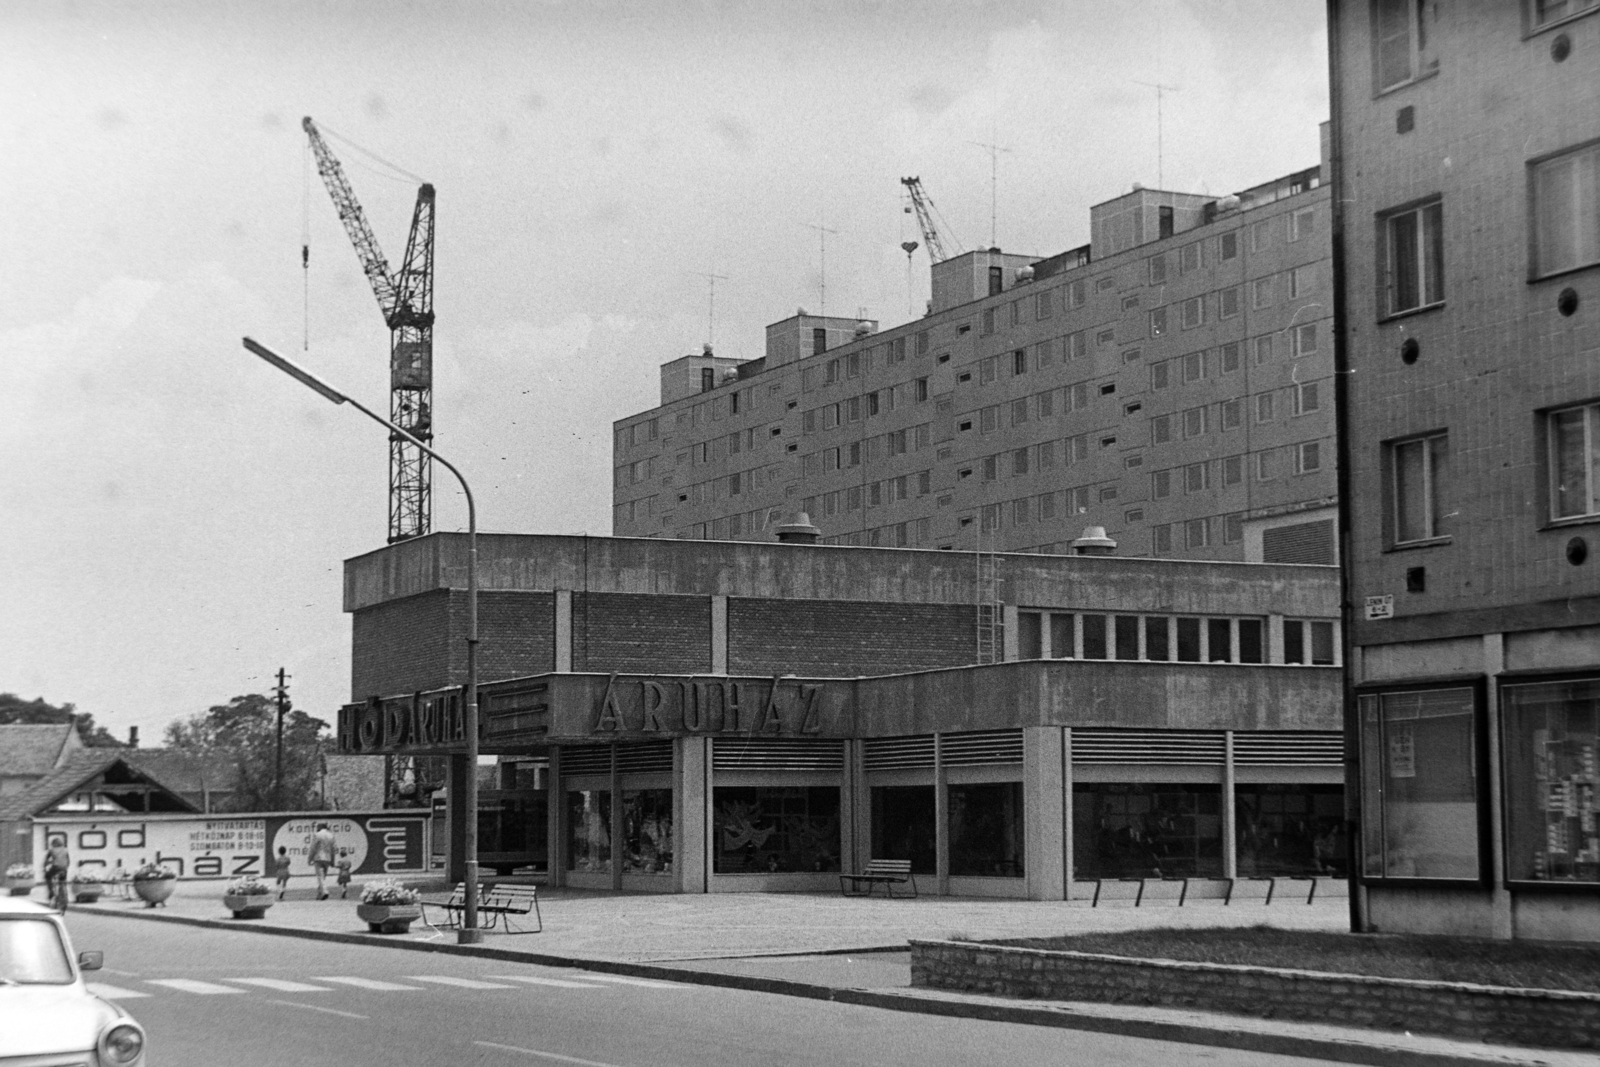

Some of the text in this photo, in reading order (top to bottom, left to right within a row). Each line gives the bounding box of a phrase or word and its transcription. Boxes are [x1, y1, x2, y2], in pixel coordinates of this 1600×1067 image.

[408, 684, 482, 745] ÁRUHÁ
[594, 671, 824, 734] ÁRUHÁZ
[44, 823, 146, 850] hód
[288, 821, 351, 833] konfkció
